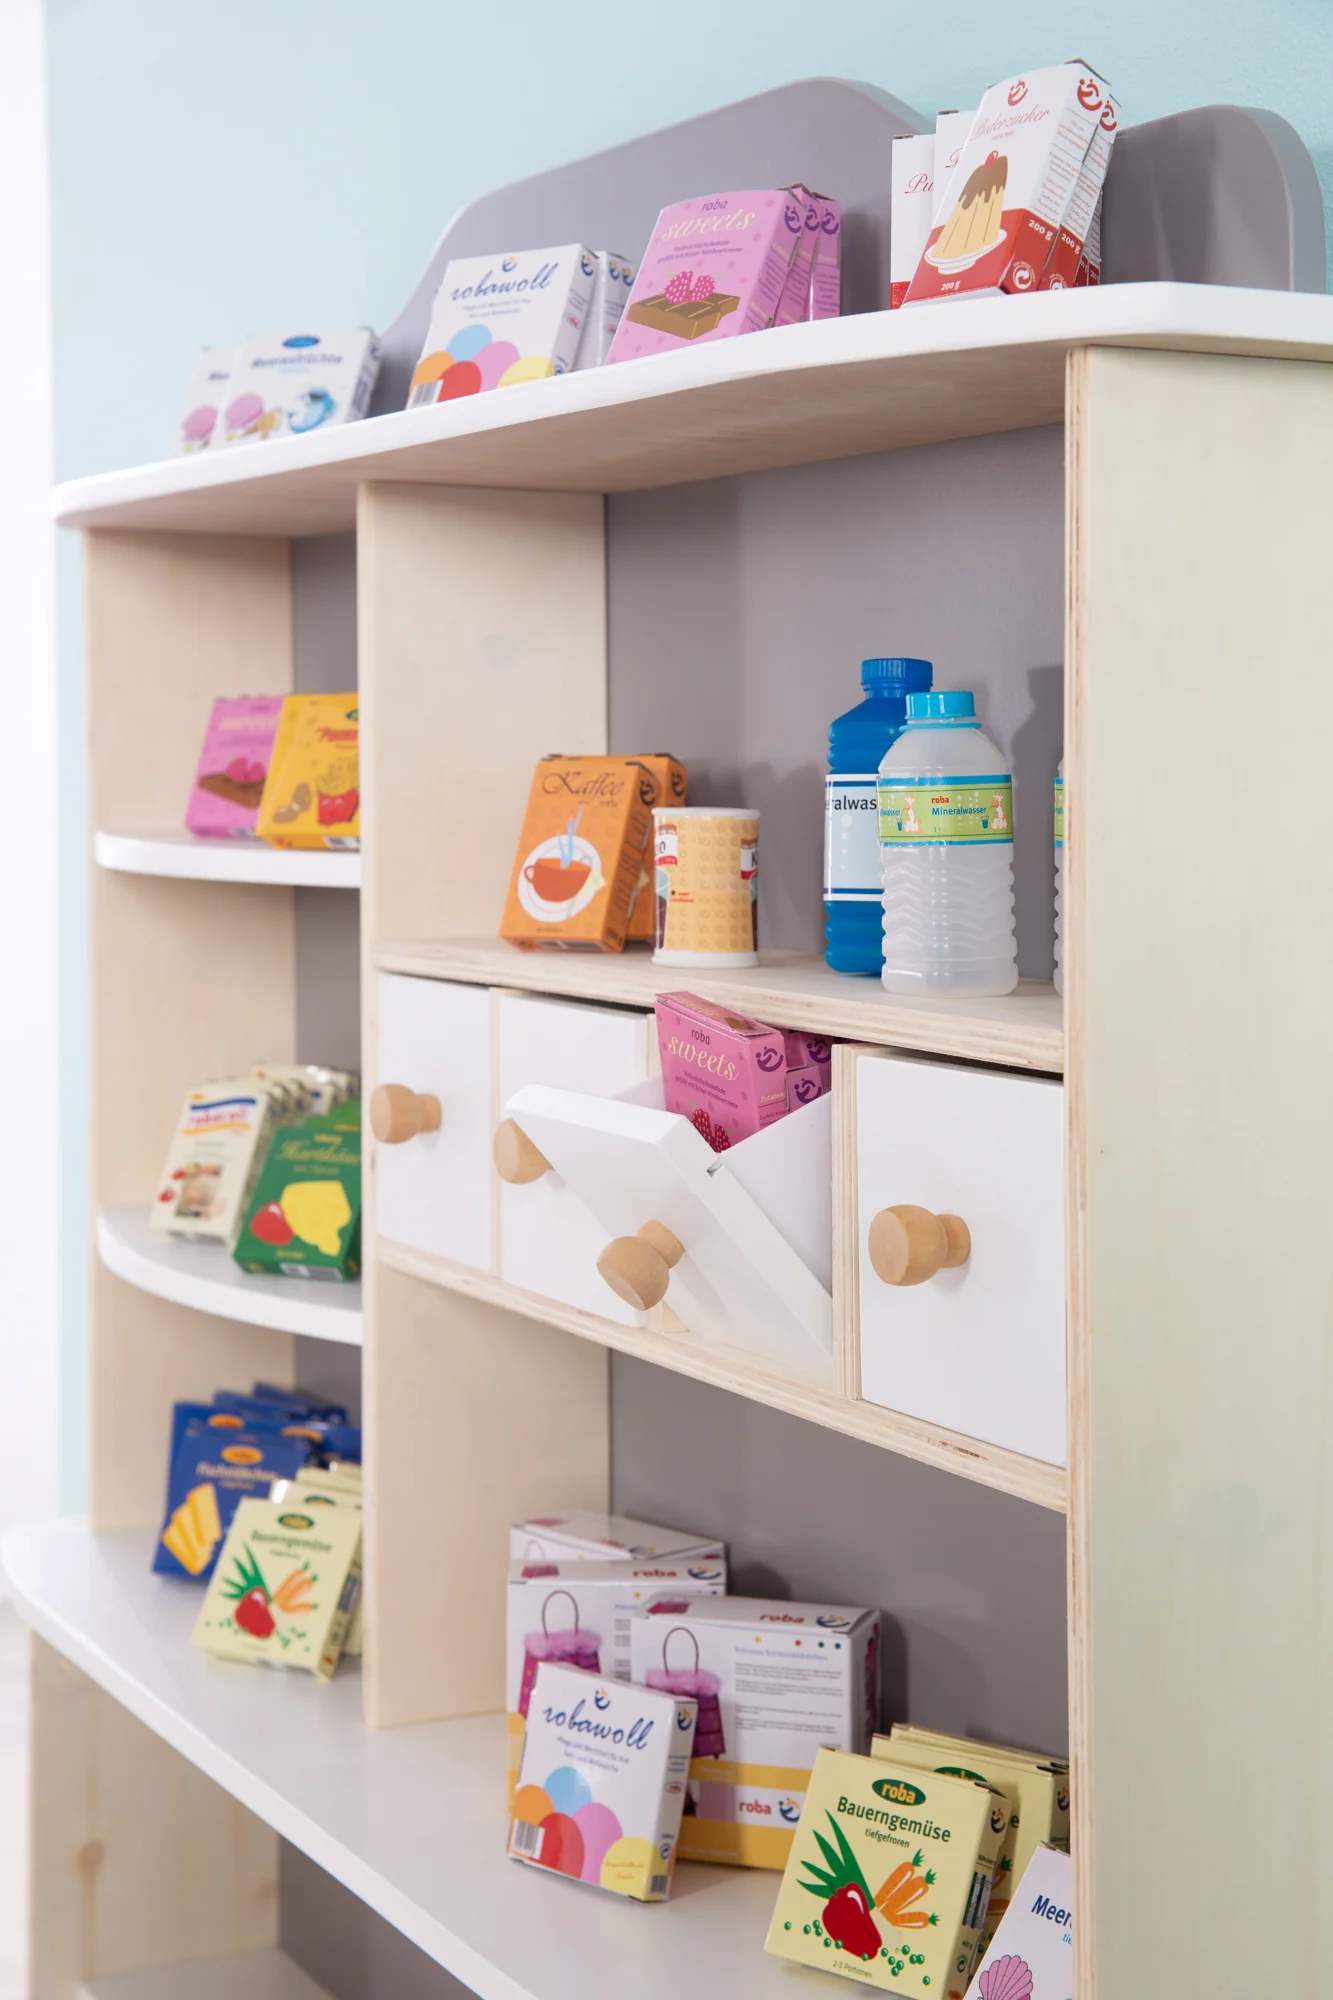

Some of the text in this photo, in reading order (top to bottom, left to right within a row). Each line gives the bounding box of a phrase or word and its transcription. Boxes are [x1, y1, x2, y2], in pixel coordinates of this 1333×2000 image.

[701, 198, 729, 212] roba
[661, 208, 761, 242] sweets
[1028, 219, 1053, 241] 200 g
[1061, 233, 1081, 255] 200 g
[450, 262, 559, 301] robawoll
[542, 770, 625, 804] Kaffee
[931, 795, 950, 804] roba
[931, 806, 987, 817] Mineralwasser
[691, 1028, 711, 1045] roba
[668, 1036, 740, 1081] sweets
[759, 1614, 805, 1624] roba
[542, 1698, 654, 1750] robawoll
[880, 1782, 917, 1805] roba
[738, 1799, 772, 1816] roba
[836, 1796, 951, 1843] Bauerngemüse
[864, 1828, 910, 1848] tiefgefroren
[1030, 1894, 1072, 1929] Meer
